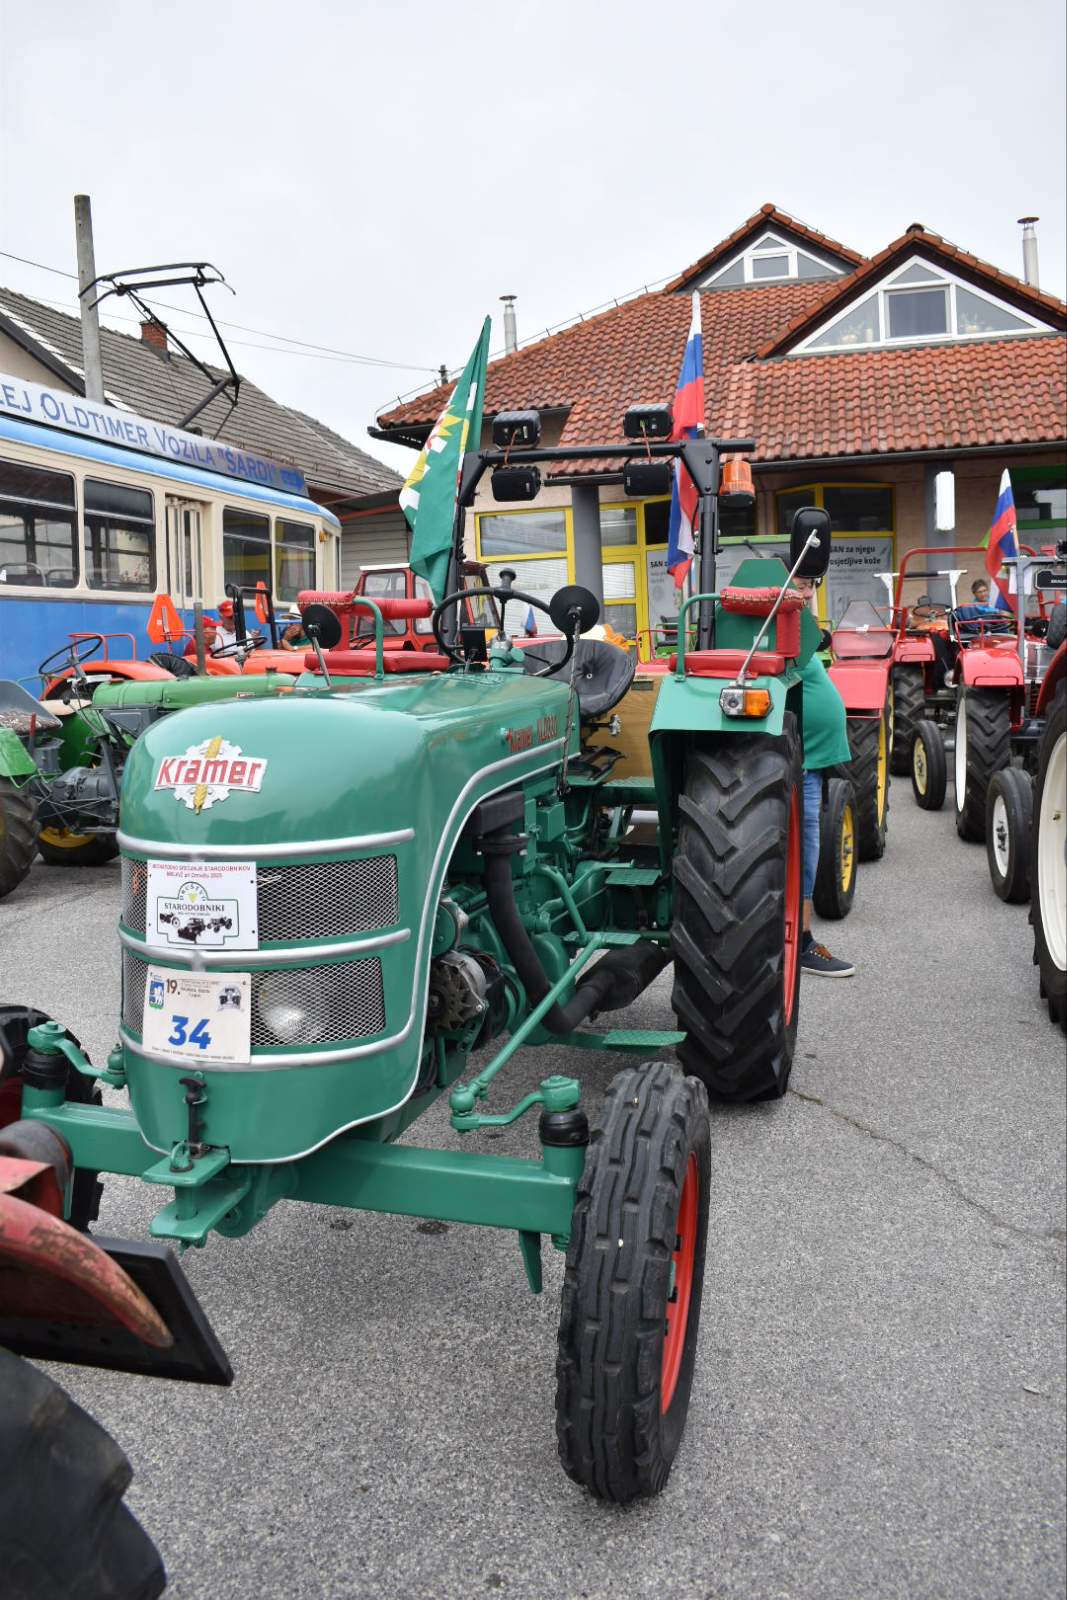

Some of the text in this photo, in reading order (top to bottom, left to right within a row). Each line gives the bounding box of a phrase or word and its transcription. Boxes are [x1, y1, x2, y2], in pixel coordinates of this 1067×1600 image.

[855, 545, 875, 554] njegu
[864, 557, 881, 565] kože
[158, 758, 262, 787] Kramer
[164, 902, 225, 913] STARODOBNIKI
[166, 978, 181, 996] 19.
[168, 1015, 212, 1050] 34
